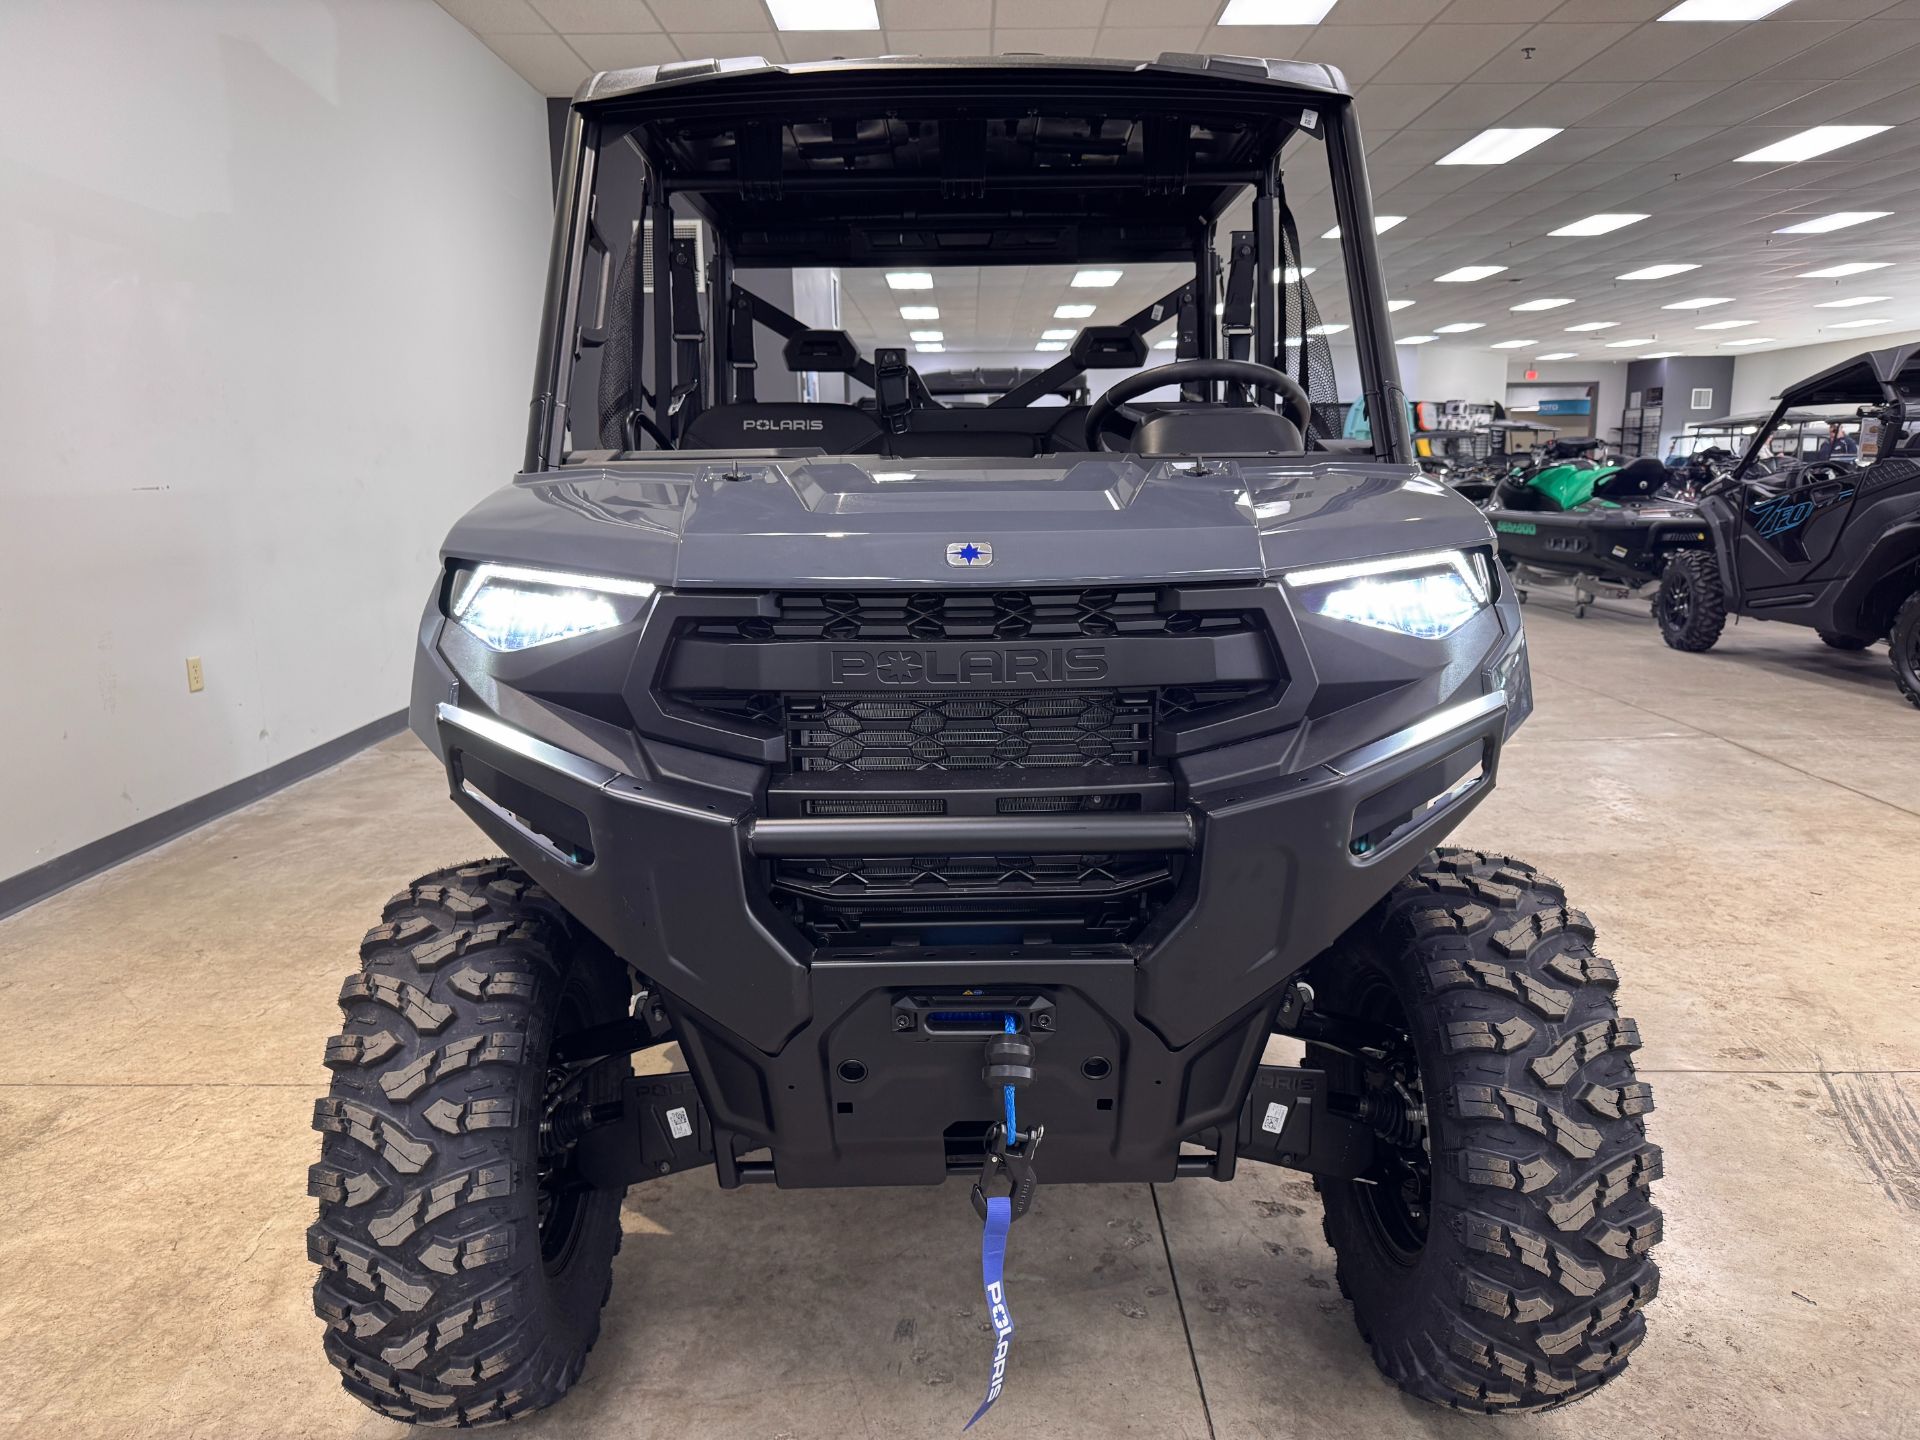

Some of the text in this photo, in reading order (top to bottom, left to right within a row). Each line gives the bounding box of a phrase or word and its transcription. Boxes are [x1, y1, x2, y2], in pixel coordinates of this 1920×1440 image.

[743, 419, 824, 431] POLARIS
[831, 647, 1109, 684] POLARIS
[987, 1280, 1013, 1403] POLARIS
